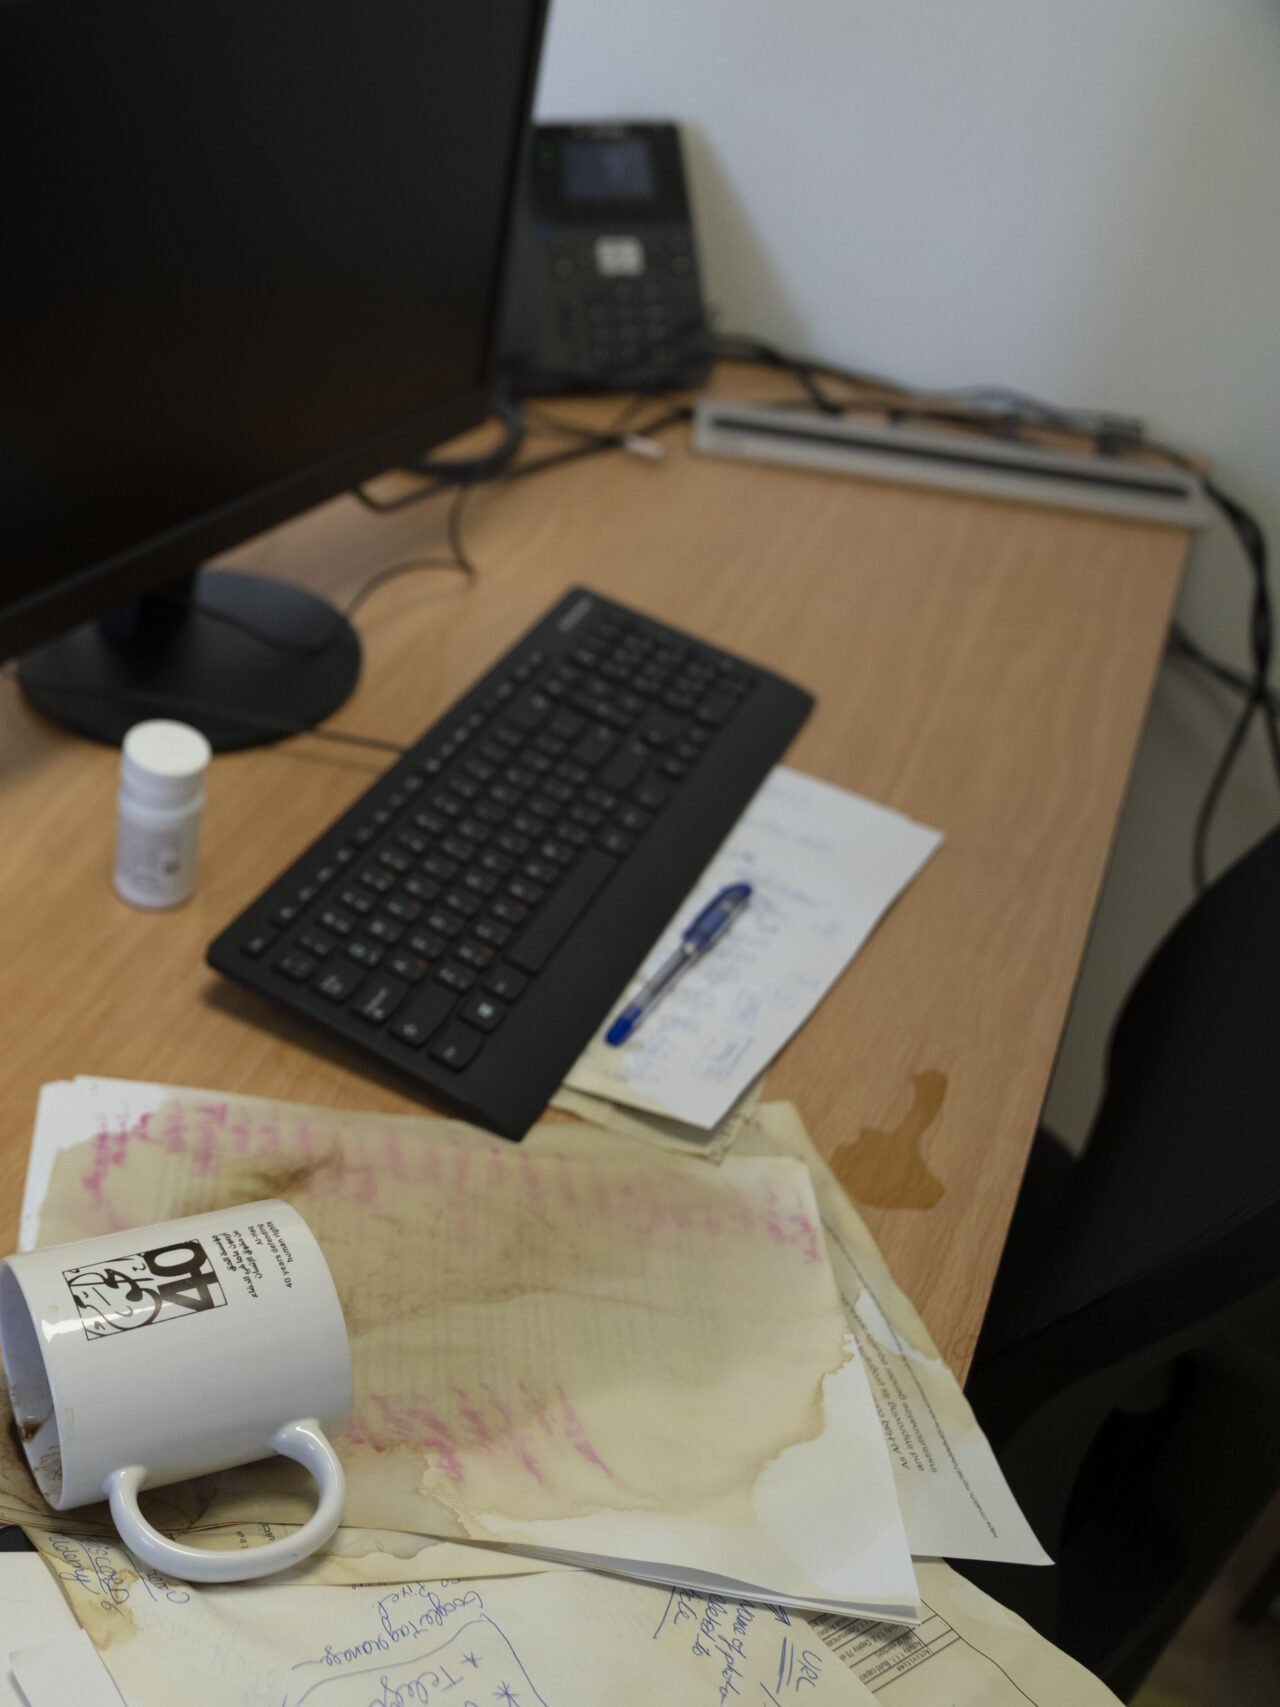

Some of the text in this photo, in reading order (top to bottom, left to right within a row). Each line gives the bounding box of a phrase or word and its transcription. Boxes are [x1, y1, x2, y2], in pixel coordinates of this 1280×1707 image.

[257, 1223, 293, 1288] 40 years defending
[266, 1221, 293, 1263] human rights
[796, 1649, 823, 1692] URL
